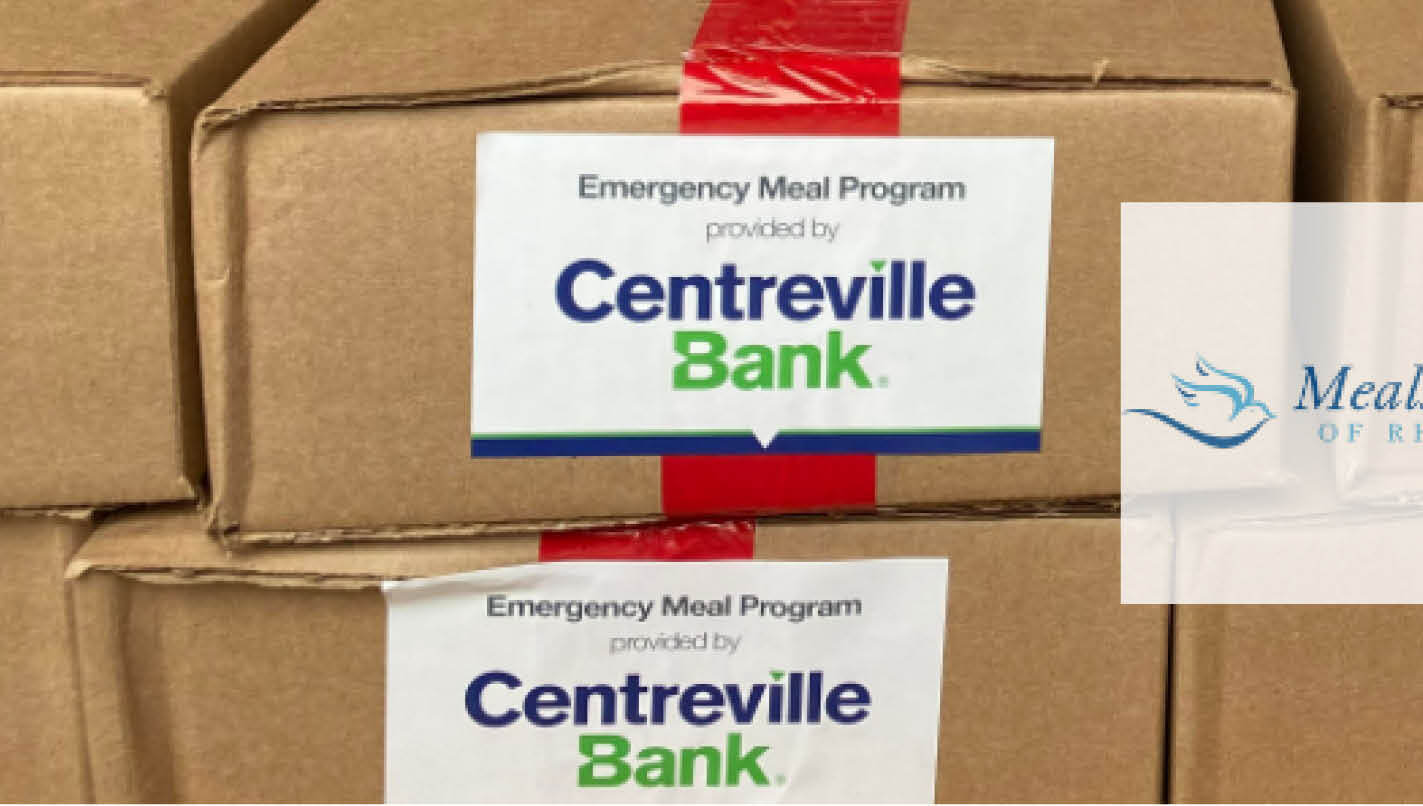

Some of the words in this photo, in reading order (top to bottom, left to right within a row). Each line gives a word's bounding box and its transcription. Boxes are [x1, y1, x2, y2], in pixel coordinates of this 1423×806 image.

[579, 174, 748, 204] Emergency
[758, 175, 829, 200] Meal
[839, 175, 964, 204] Program
[706, 218, 805, 241] provided
[811, 218, 840, 241] by
[555, 258, 976, 322] Centreville
[672, 330, 872, 389] Bank
[486, 595, 653, 622] Emergency
[662, 595, 732, 617] Meal
[739, 596, 862, 620] Program
[609, 632, 706, 654] provided
[713, 632, 742, 653] by
[464, 670, 872, 728] Centreville
[576, 732, 772, 788] Bank
